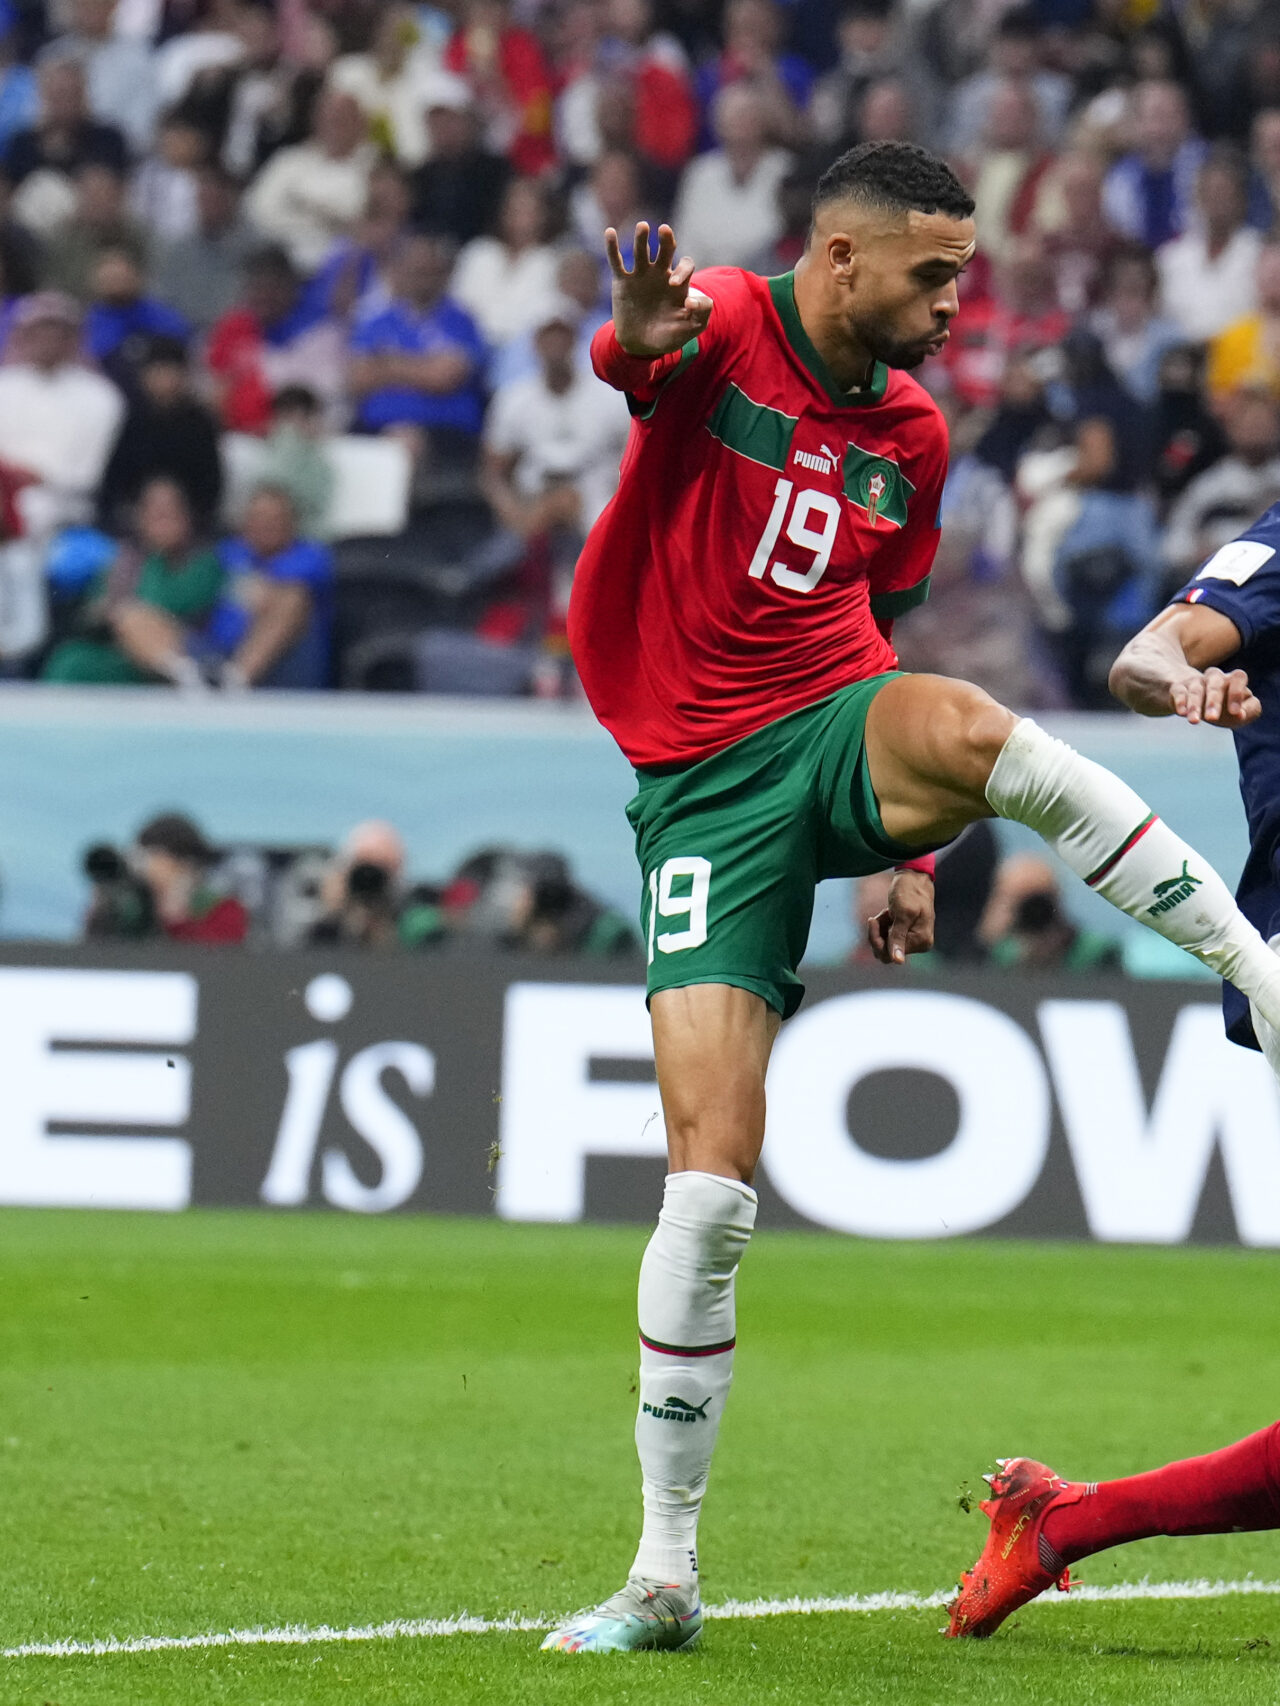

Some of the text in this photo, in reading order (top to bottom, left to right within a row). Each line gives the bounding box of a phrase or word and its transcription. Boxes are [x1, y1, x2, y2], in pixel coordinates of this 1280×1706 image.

[793, 449, 831, 475] PUMA
[748, 477, 842, 594] 19
[648, 856, 712, 966] 19
[1146, 882, 1197, 916] PUMA
[259, 972, 437, 1213] is
[642, 1402, 697, 1422] PUMA
